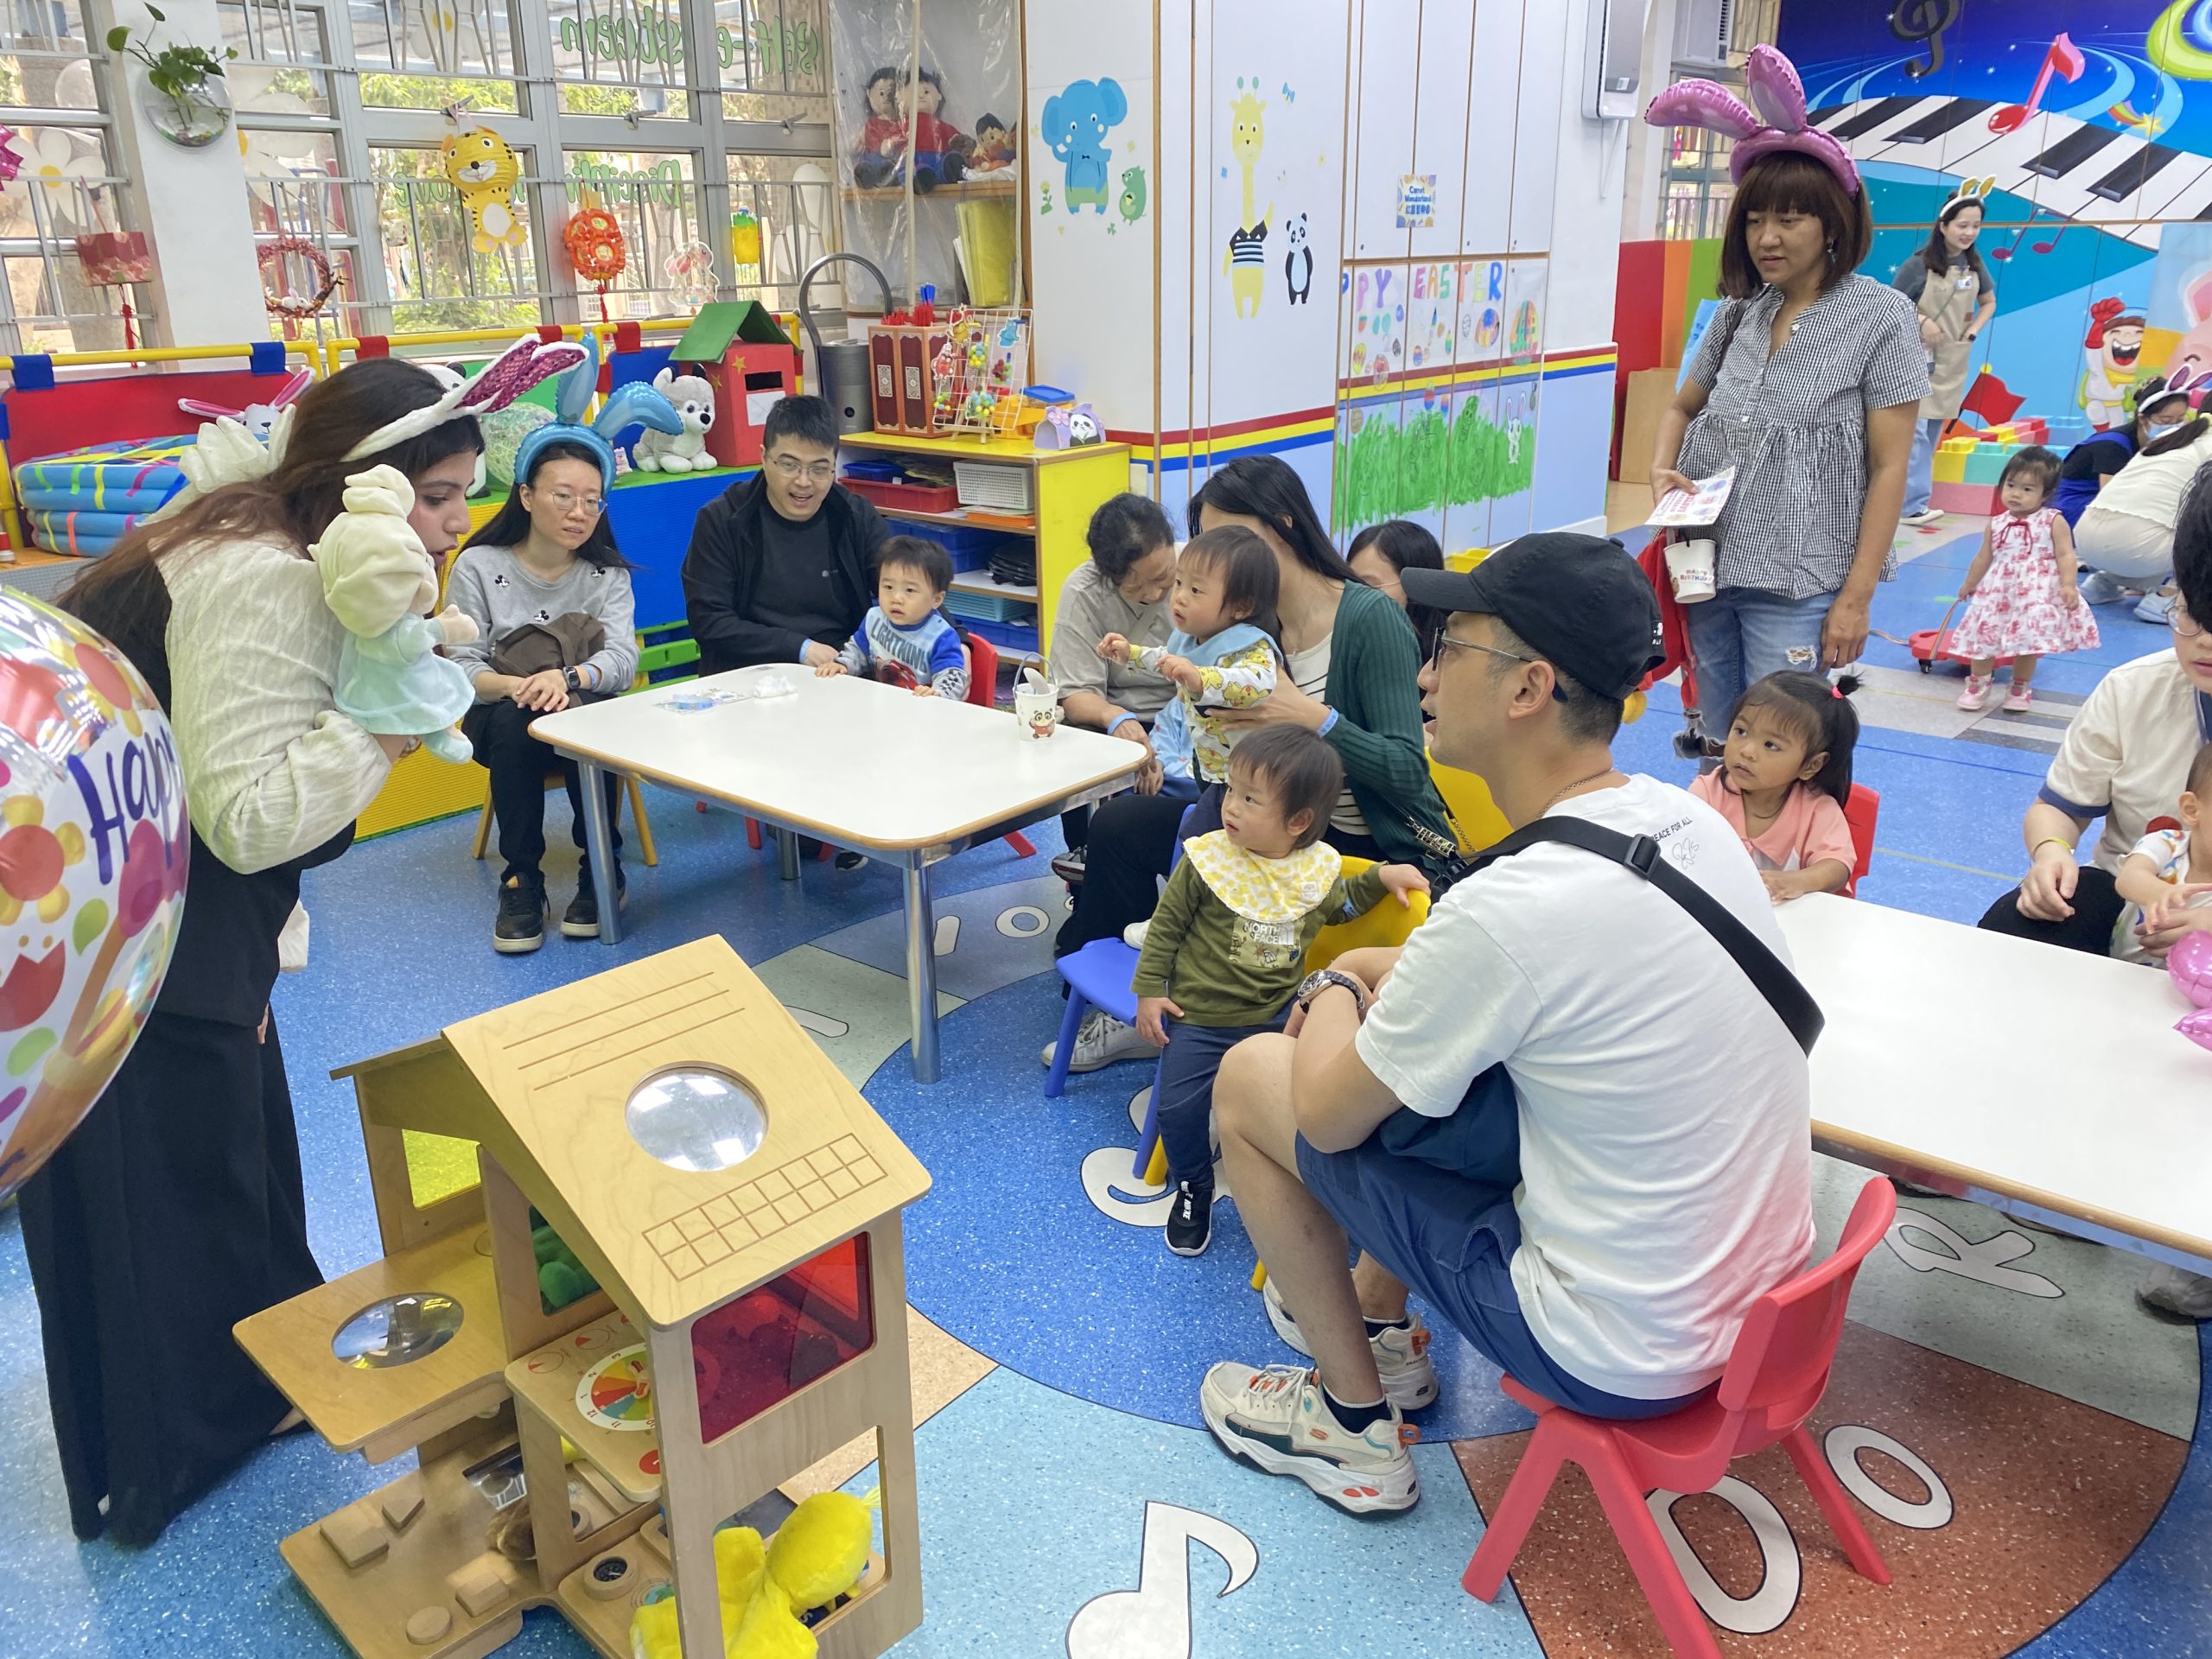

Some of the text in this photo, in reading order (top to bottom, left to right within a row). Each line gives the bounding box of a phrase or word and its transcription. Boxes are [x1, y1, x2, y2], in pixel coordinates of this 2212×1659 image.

[1413, 261, 1503, 303] EASTER
[870, 617, 930, 674] LIGHTNING
[1670, 821, 1683, 834] FOR
[1681, 816, 1693, 827] ALL
[1244, 922, 1281, 936] NORTH
[1254, 933, 1280, 944] FACE
